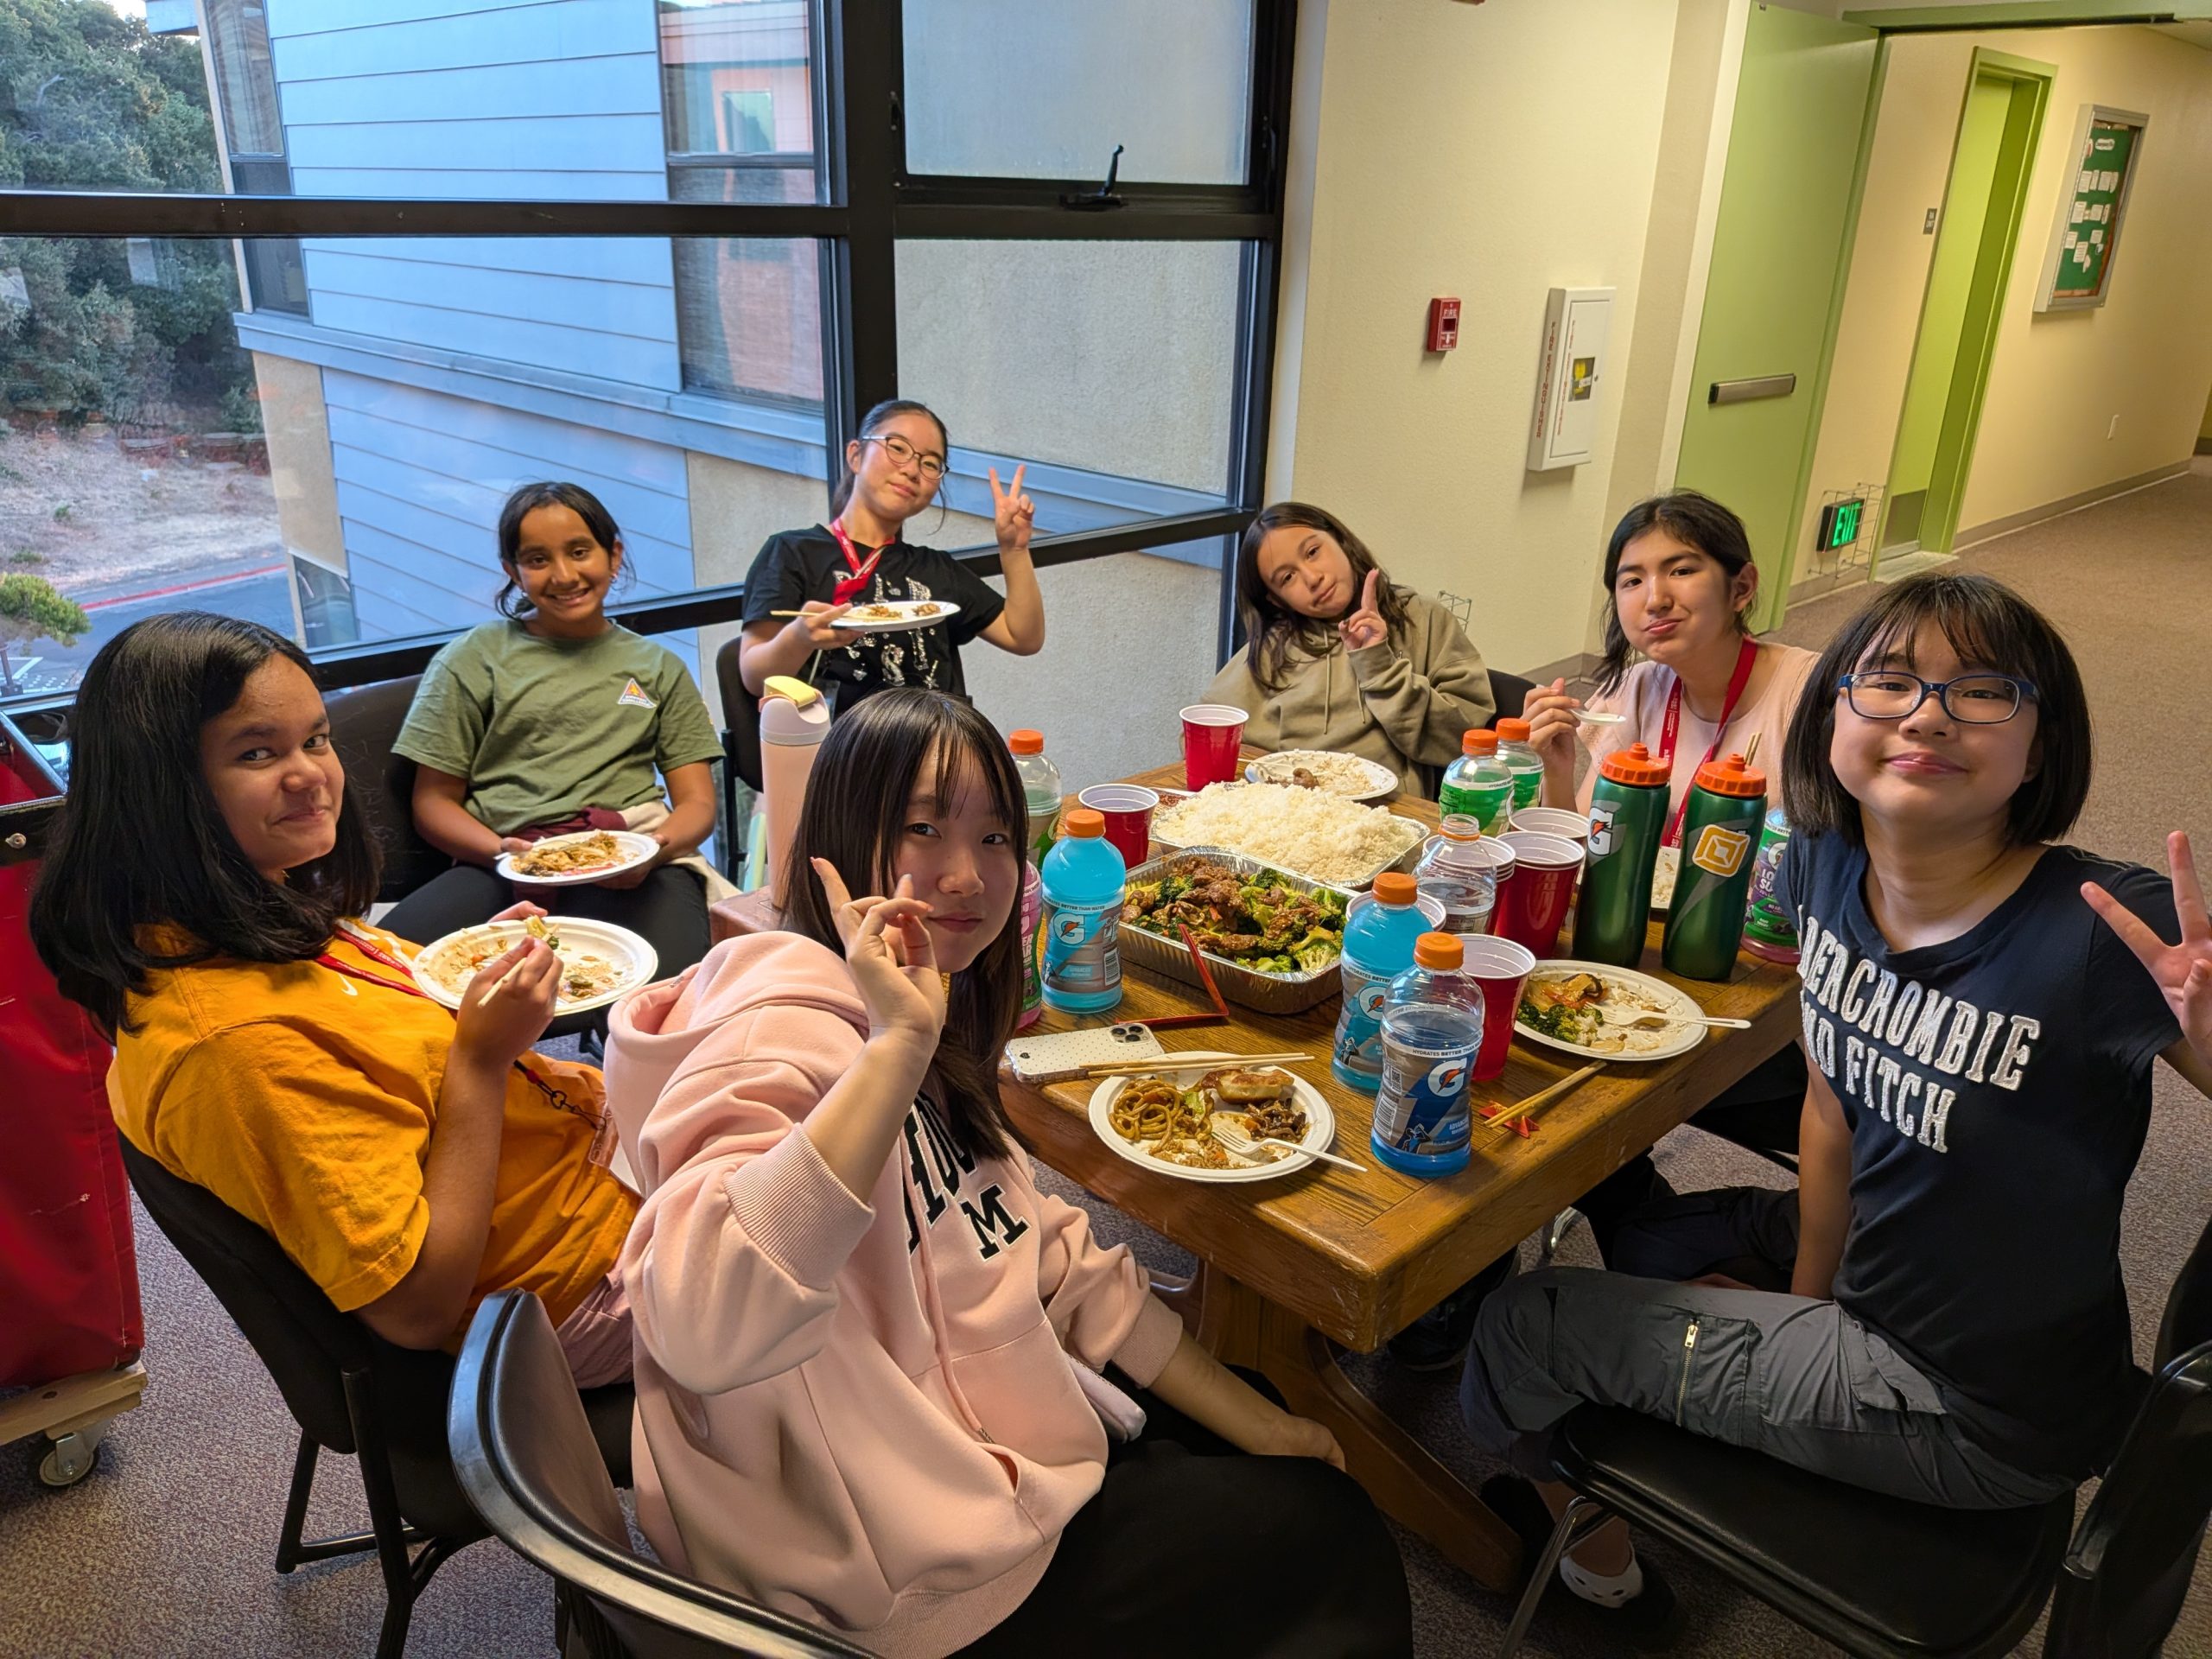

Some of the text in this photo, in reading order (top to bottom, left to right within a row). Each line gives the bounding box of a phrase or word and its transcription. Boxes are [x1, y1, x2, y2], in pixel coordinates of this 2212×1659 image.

[1832, 502, 1862, 546] EXIT
[1053, 912, 1085, 944] G
[1348, 965, 1371, 979] HYDRATES
[1412, 1049, 1440, 1058] HYDRATES
[1428, 1058, 1467, 1097] G
[1846, 1036, 1956, 1154] FITCH
